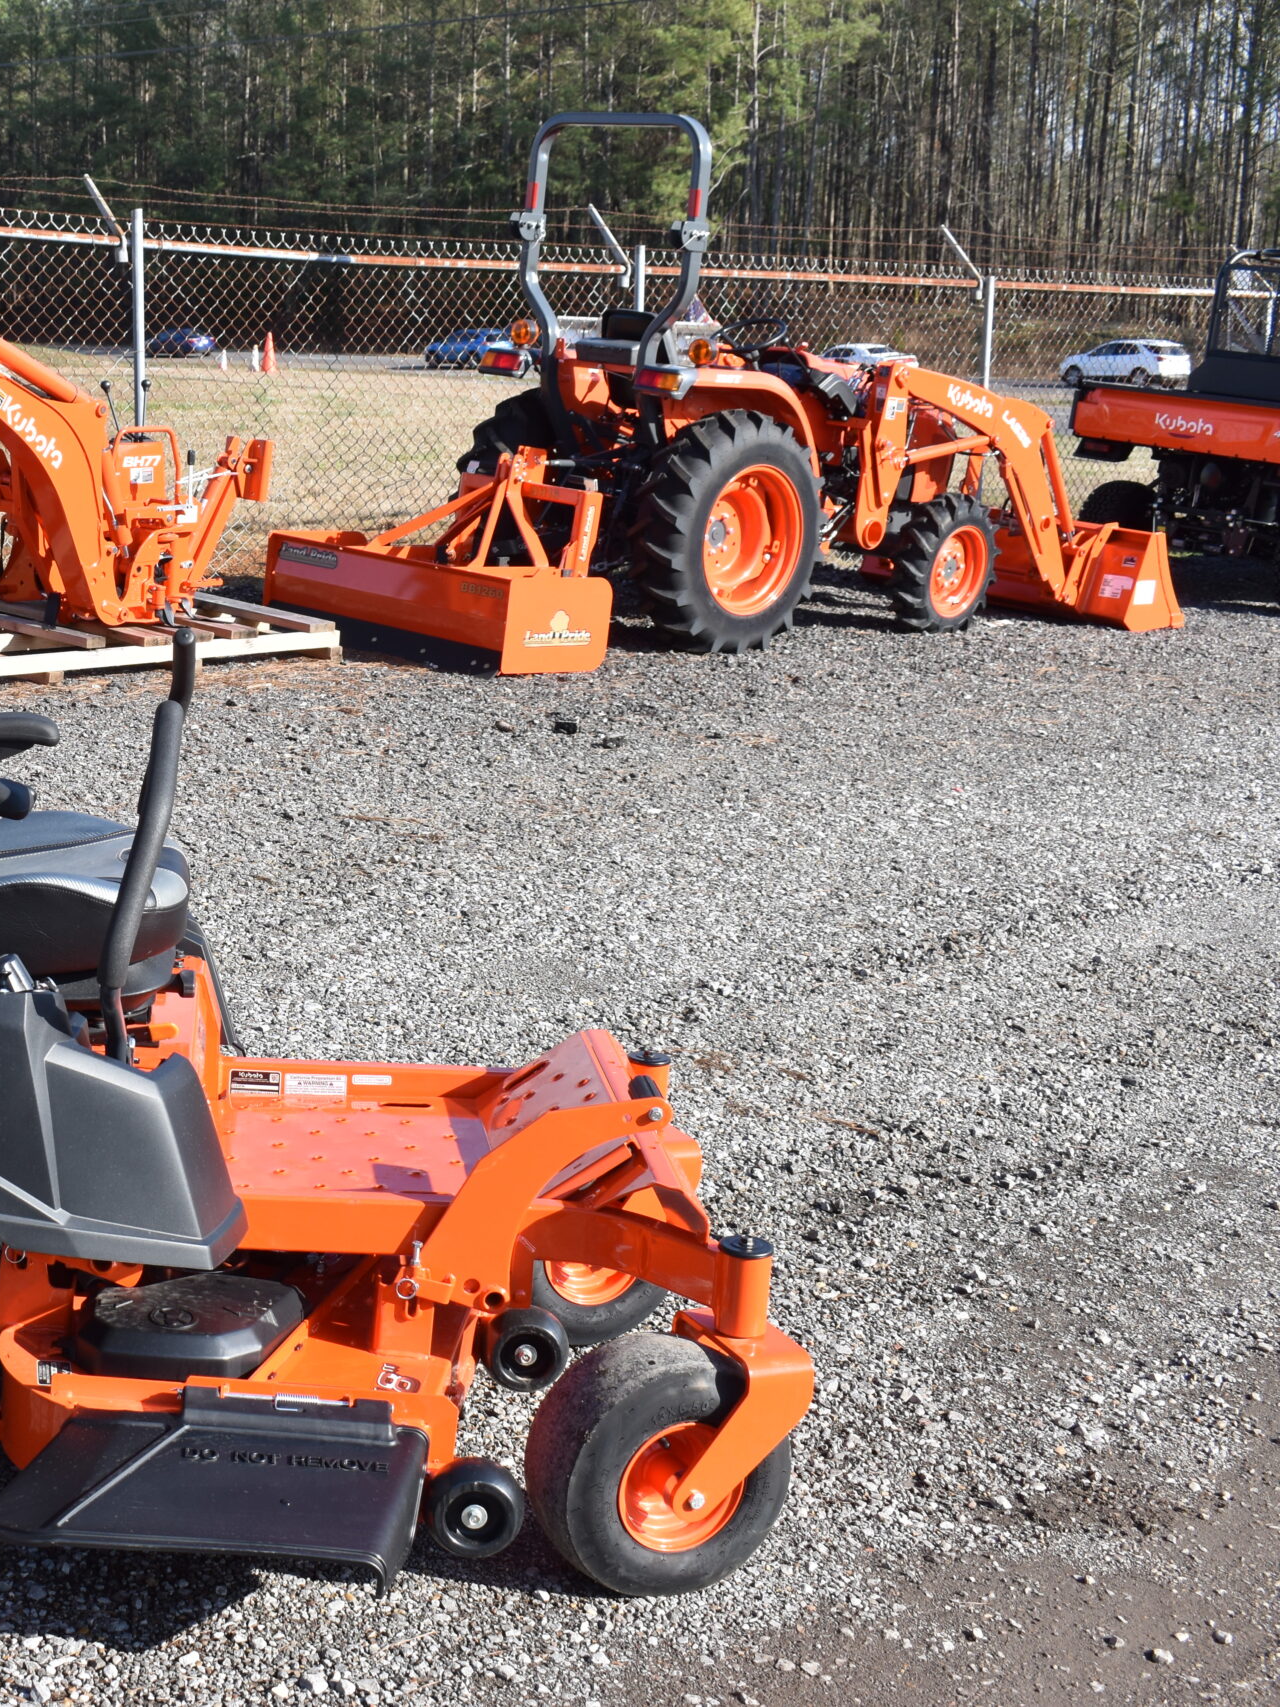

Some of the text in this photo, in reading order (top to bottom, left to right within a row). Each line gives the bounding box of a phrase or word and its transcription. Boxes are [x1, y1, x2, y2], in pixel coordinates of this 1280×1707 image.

[946, 383, 994, 418] Kubota
[1, 396, 63, 470] Kubota
[1155, 412, 1214, 436] Kubota
[122, 455, 161, 468] BH77
[525, 629, 591, 642] Land Pride
[238, 1071, 264, 1079] Kubota
[182, 1447, 390, 1474] DO NOT REMOVE
